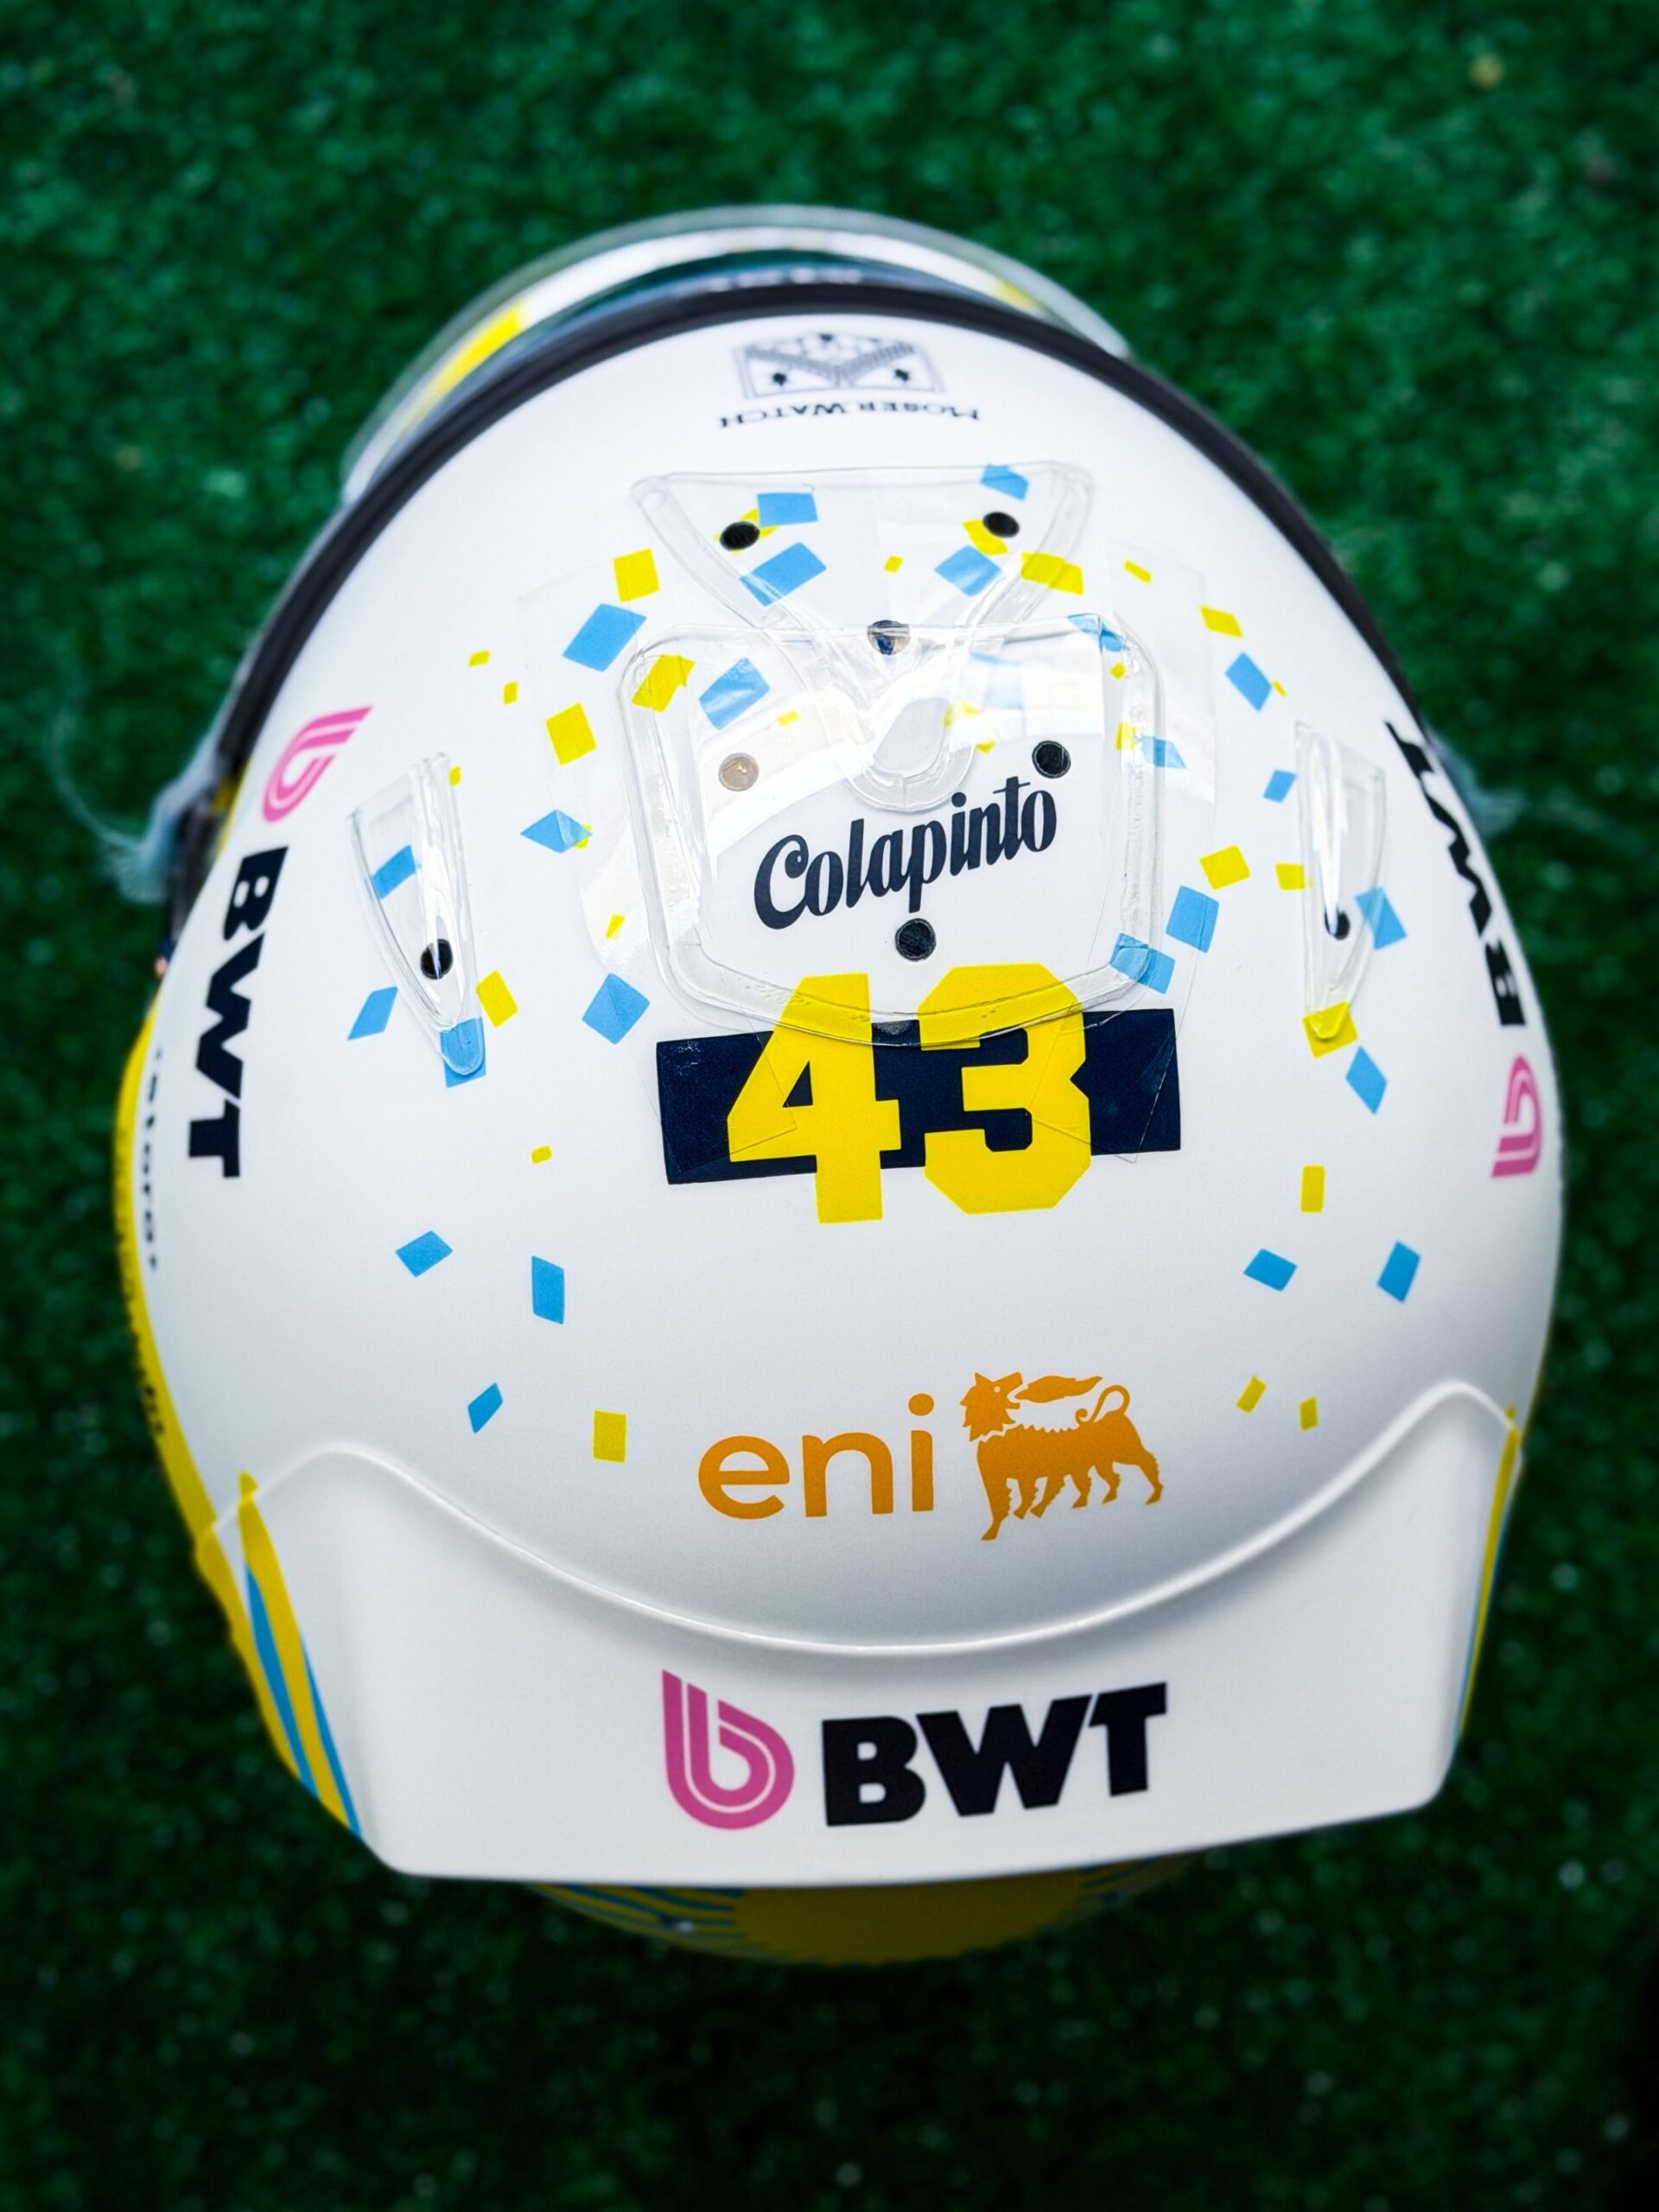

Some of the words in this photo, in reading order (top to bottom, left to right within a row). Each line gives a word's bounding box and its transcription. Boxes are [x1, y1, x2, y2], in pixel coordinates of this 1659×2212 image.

[718, 403, 847, 429] WATCH
[860, 401, 981, 422] MOSER
[754, 776, 1058, 930] Colapinto
[1383, 721, 1527, 1027] BWT
[188, 846, 289, 1178] BWT
[727, 963, 1091, 1224] 43
[698, 1392, 935, 1520] eni
[822, 1681, 1167, 1827] BWT
